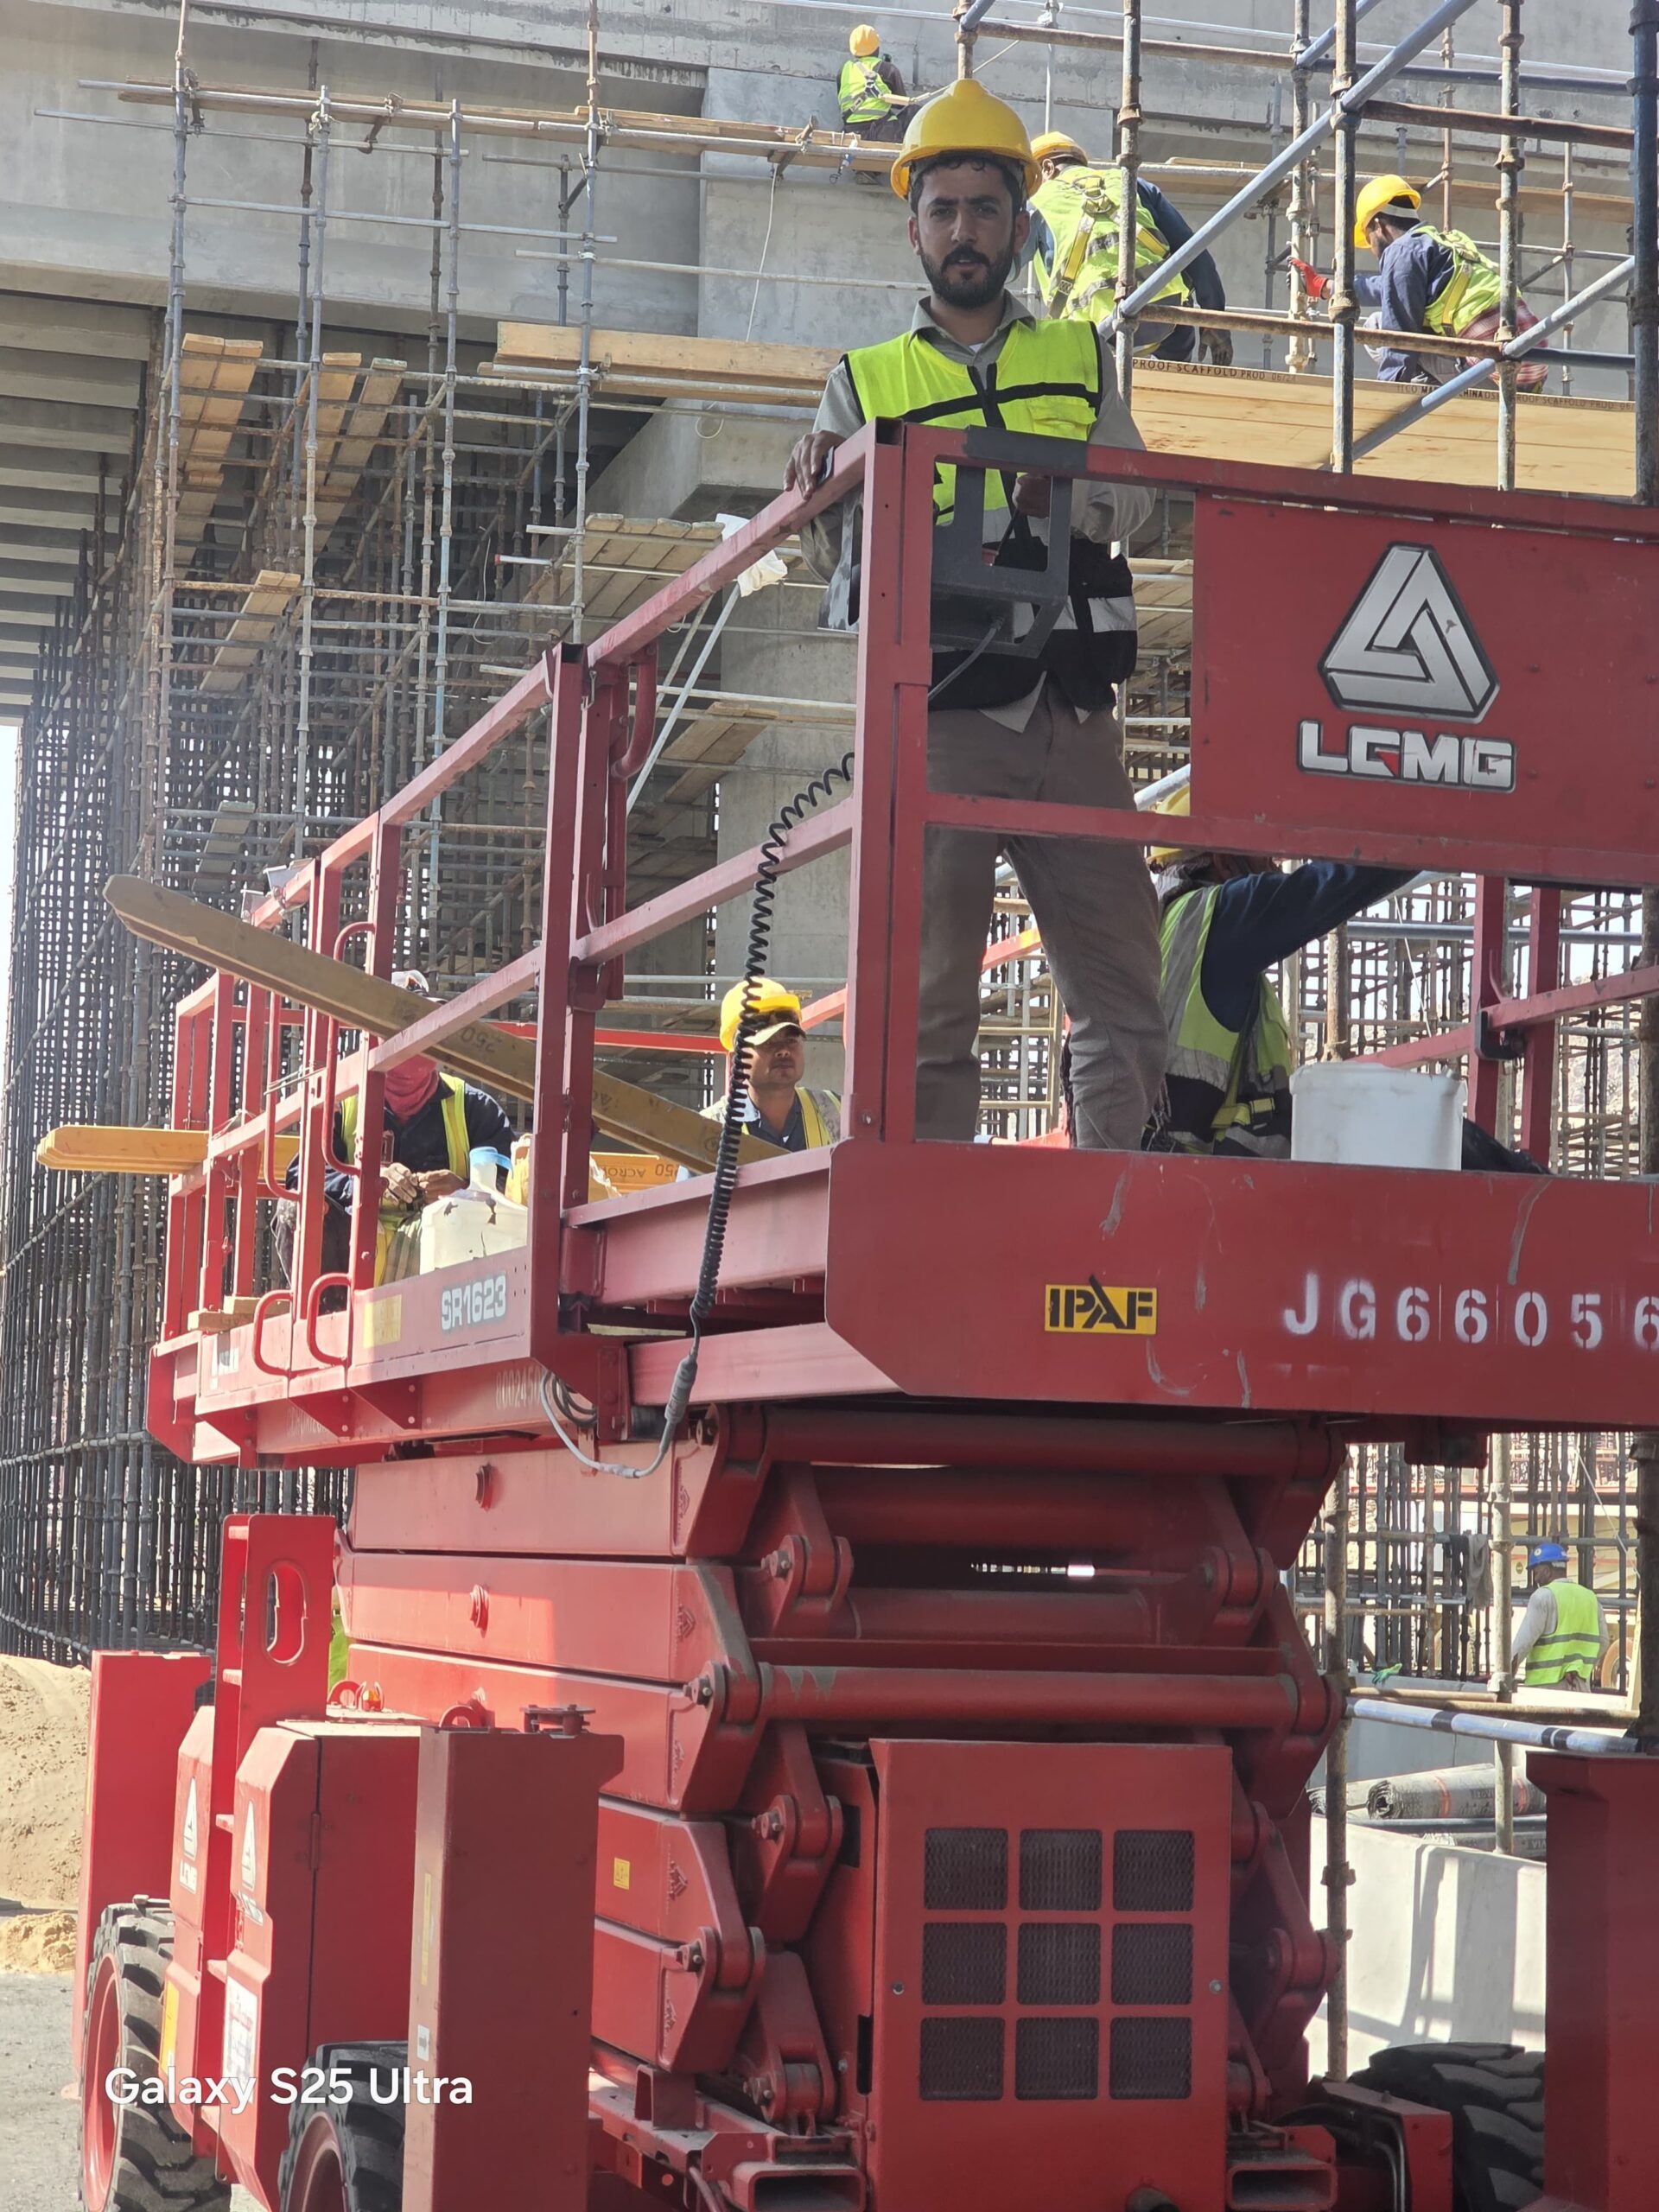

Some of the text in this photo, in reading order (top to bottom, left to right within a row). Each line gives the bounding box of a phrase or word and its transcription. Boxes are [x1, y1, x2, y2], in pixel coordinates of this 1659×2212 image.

[1133, 359, 1172, 371] PROOF
[1177, 363, 1237, 378] SCAFFOLD
[1241, 370, 1266, 380] PROD
[1459, 390, 1484, 398] HINA
[1516, 394, 1541, 404] ROOF
[1298, 720, 1515, 790] LGMG
[442, 1274, 506, 1331] SR1623
[1048, 1274, 1154, 1331] IPAF
